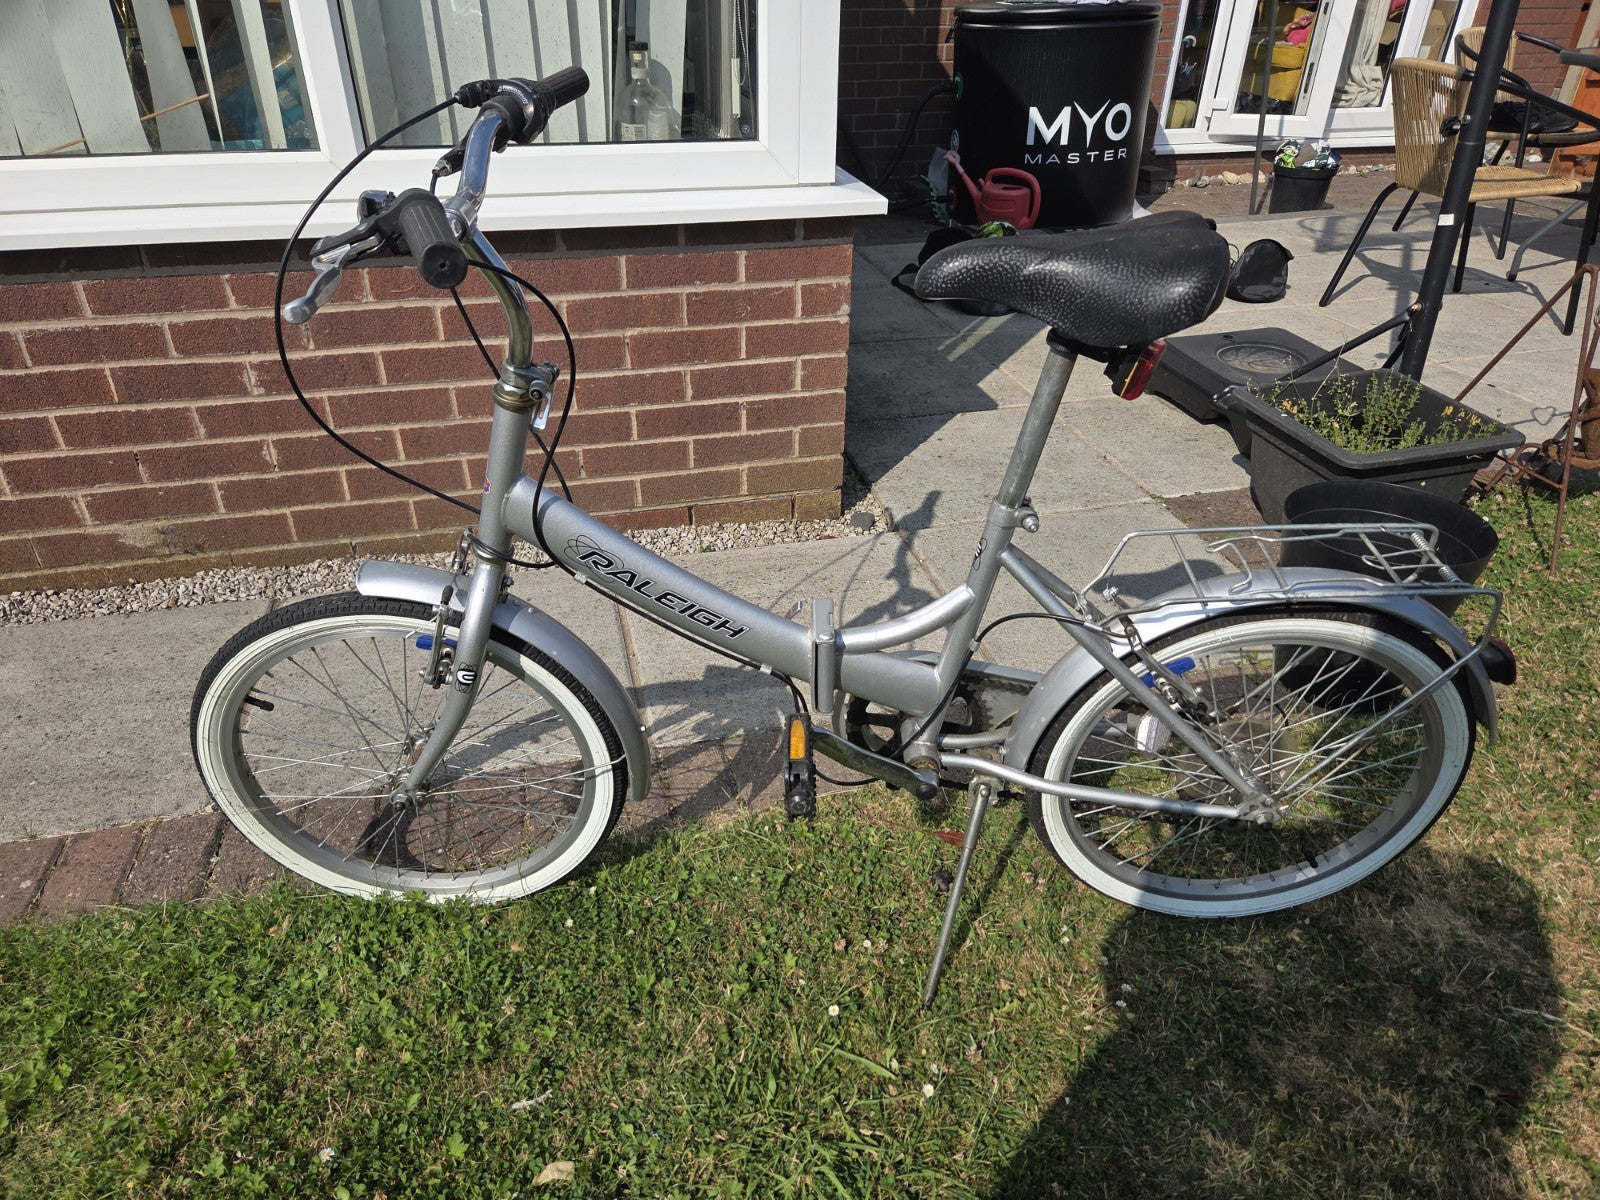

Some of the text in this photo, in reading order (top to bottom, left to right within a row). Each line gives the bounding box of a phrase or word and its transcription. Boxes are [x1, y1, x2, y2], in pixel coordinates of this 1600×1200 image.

[1026, 99, 1132, 148] MYO
[1024, 148, 1127, 164] MASTER
[577, 550, 750, 640] RALEIGH
